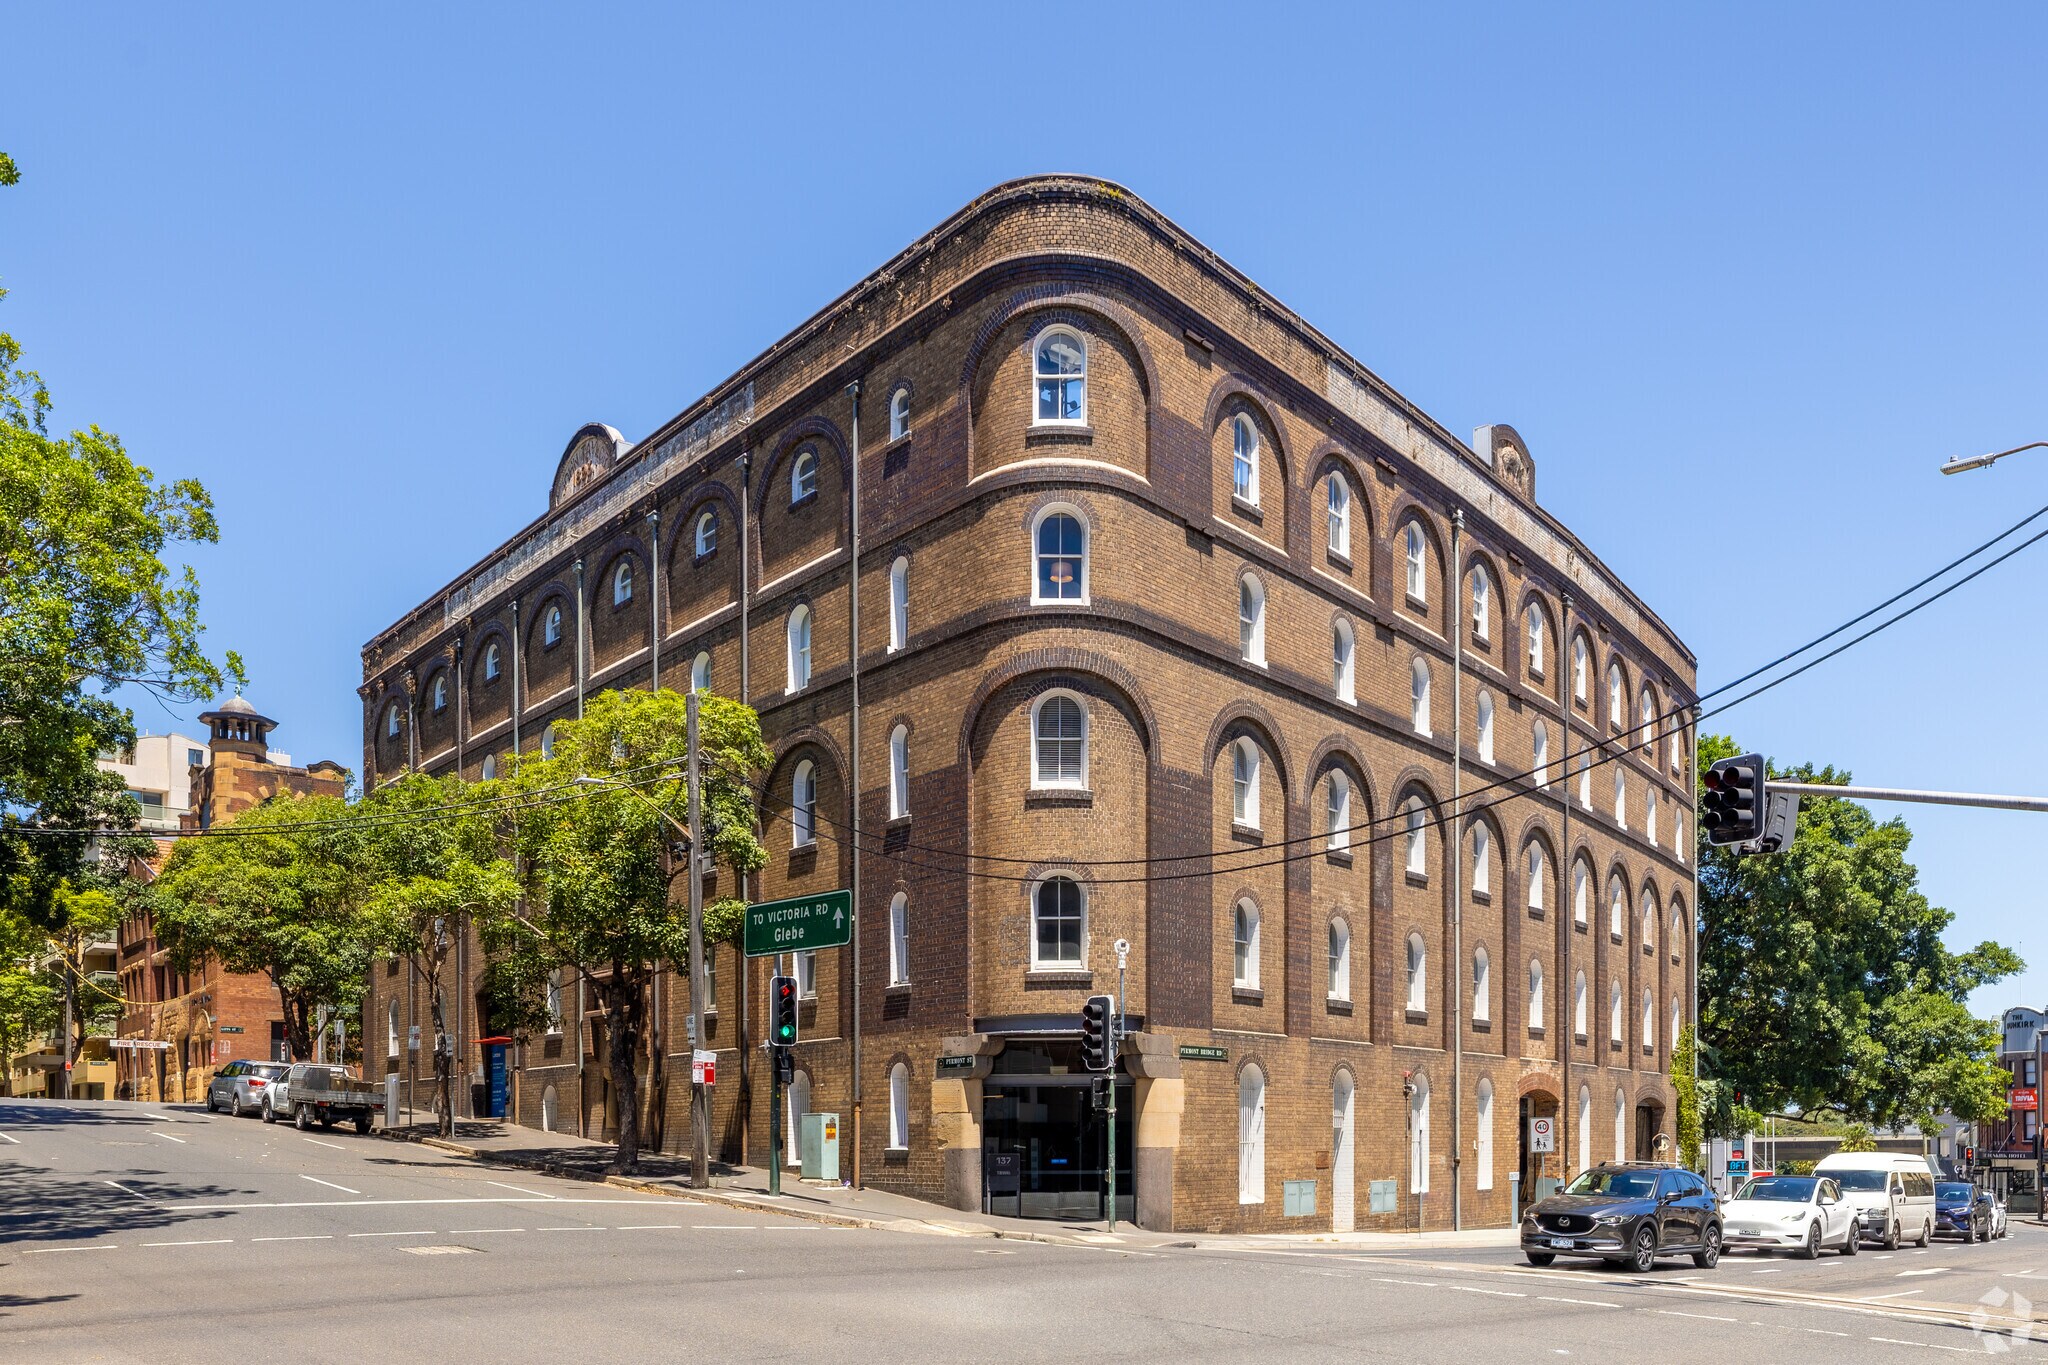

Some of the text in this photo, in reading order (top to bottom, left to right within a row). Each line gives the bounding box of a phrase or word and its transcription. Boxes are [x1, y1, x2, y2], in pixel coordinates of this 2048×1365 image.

[753, 903, 829, 925] TO VICTORIA RD
[774, 926, 805, 942] Glebe
[996, 1157, 1012, 1165] 137
